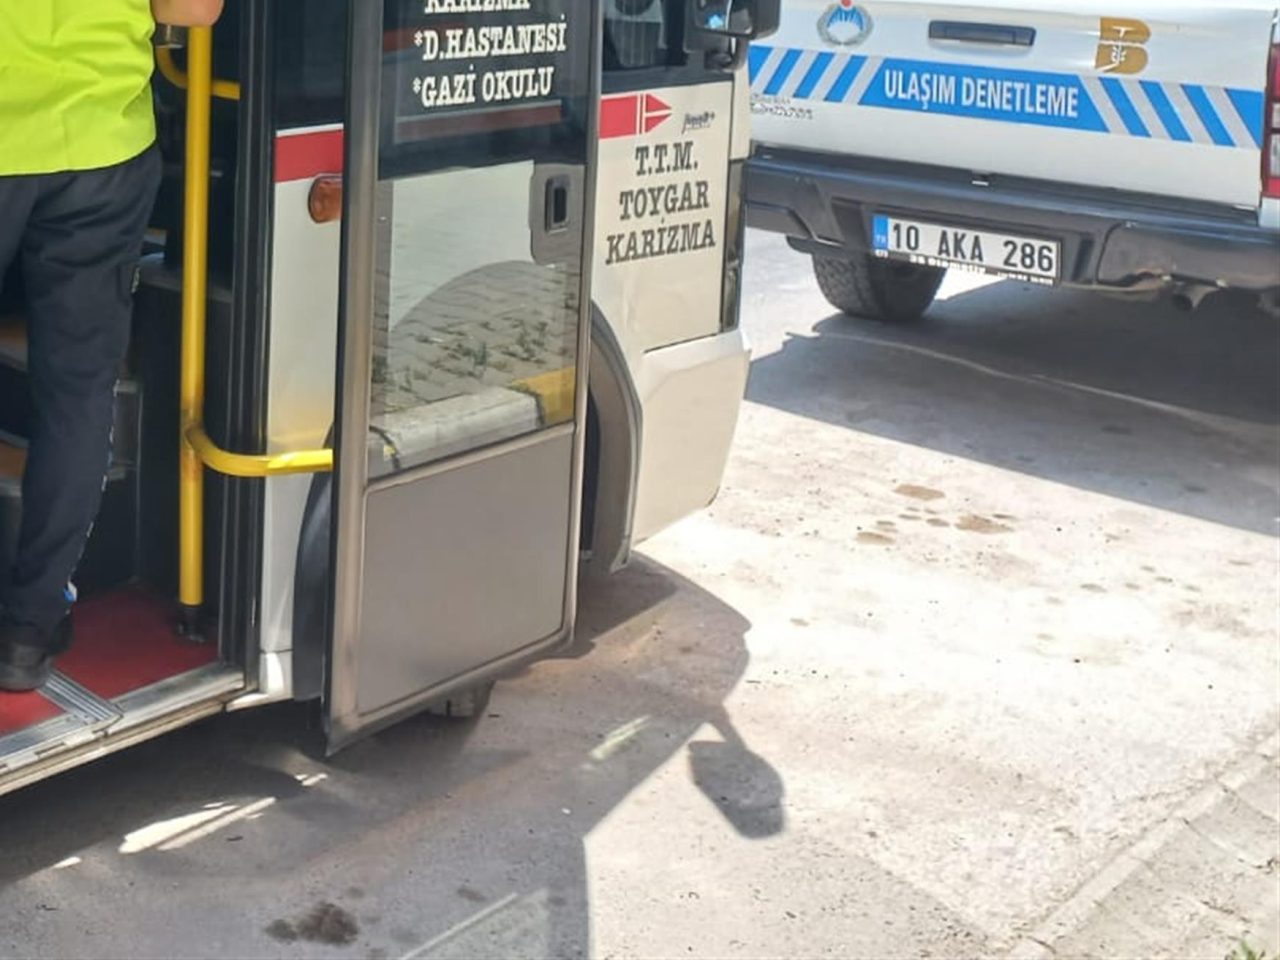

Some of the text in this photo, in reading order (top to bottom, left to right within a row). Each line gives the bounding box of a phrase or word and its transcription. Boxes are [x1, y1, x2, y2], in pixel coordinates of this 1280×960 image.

[481, 66, 555, 102] OKULU
[884, 68, 1080, 119] ULAŞIM DENETLEME
[635, 140, 699, 177] T.T.M.
[619, 180, 710, 221] TOYGAR
[605, 217, 716, 266] KARİZMA
[892, 222, 920, 252] 10
[937, 229, 985, 263] AKA
[1002, 239, 1055, 273] 286
